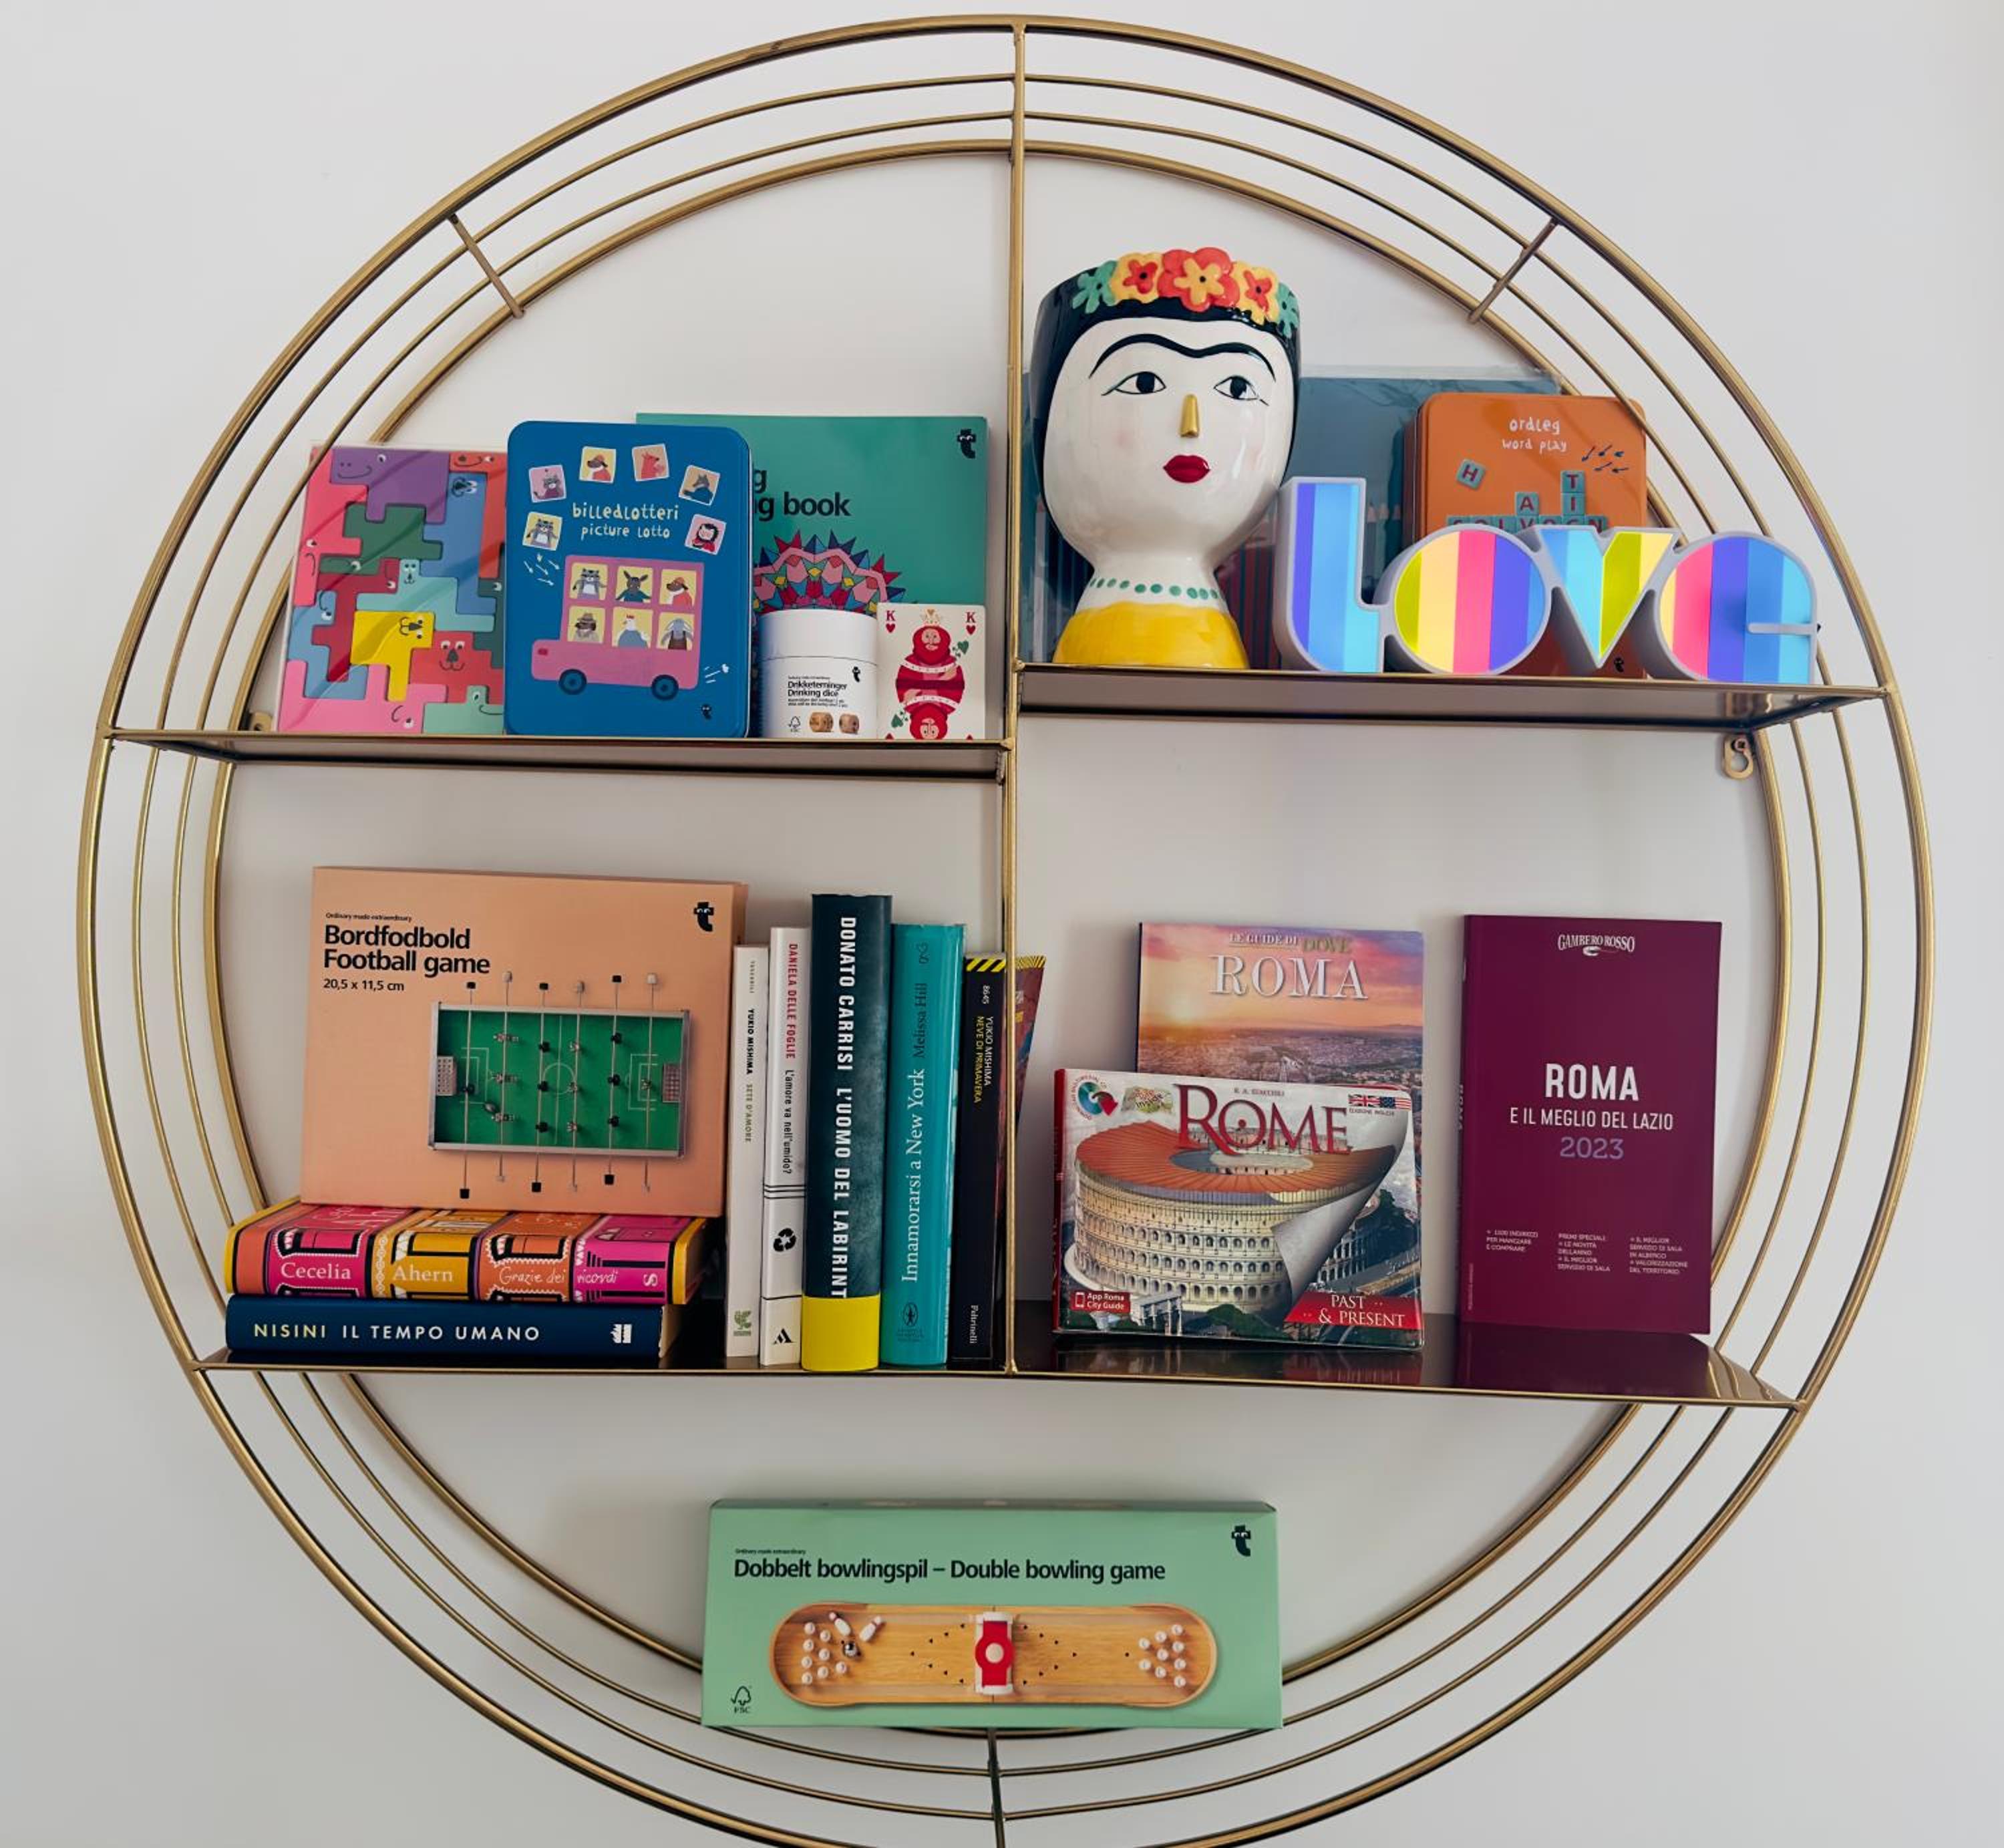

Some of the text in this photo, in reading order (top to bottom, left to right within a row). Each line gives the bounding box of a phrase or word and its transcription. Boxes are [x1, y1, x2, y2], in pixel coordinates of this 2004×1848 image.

[1508, 417, 1561, 434] ordleg
[1502, 438, 1567, 454] word play
[572, 502, 679, 520] billedlotteri
[783, 491, 852, 517] book
[580, 523, 671, 541] picture lotto
[886, 610, 896, 622] K
[965, 611, 977, 623] K
[788, 689, 821, 698] Drinking
[325, 924, 471, 949] Bordfodbold
[1229, 933, 1244, 943] LE
[1246, 934, 1283, 944] GUIDE
[1285, 936, 1299, 945] DI
[1557, 934, 1636, 953] GAMBERO ROSSO
[324, 948, 491, 978] Football game
[788, 943, 798, 985] DANIELA
[323, 978, 348, 990] 20,5
[361, 979, 384, 991] 11,5
[387, 983, 405, 991] cm
[1208, 955, 1369, 1000] ROMA
[982, 984, 991, 1004] 8645
[787, 991, 797, 1020] DELLE
[747, 1008, 755, 1035] YUKIO
[786, 1024, 796, 1059] FOGLIE
[984, 1016, 994, 1086] YUKIO MISHIMA
[746, 1036, 754, 1075] MISHIMA
[973, 1016, 985, 1103] NEVE DI PRIMAVERA
[784, 1070, 795, 1104] L'amore
[1544, 1063, 1639, 1101] ROMA
[745, 1084, 754, 1102] SETE
[784, 1107, 792, 1118] va
[831, 917, 856, 1298] DONATO CARRISI L'UOMO DEL LABIRINT
[1172, 1083, 1353, 1155] ROME
[1510, 1107, 1674, 1130] E IL MEGLIO DEL LAZIO
[902, 983, 929, 1283] Innamorarsi a New York Melissa Hill
[1560, 1136, 1625, 1160] 2023
[281, 1262, 453, 1282] Cecelia Ahern
[498, 1265, 619, 1285] Grazie dei ricordi
[1087, 1301, 1125, 1310] City Guide
[1331, 1294, 1365, 1309] PAST
[1318, 1307, 1405, 1326] & PRESENT
[254, 1324, 540, 1341] NISINI IL TEMPO UMANO
[735, 1558, 812, 1577] Dobbelt
[818, 1558, 928, 1584] bowlingspil
[951, 1559, 1020, 1579] Double
[1025, 1559, 1105, 1585] bowling
[1110, 1564, 1166, 1584] game
